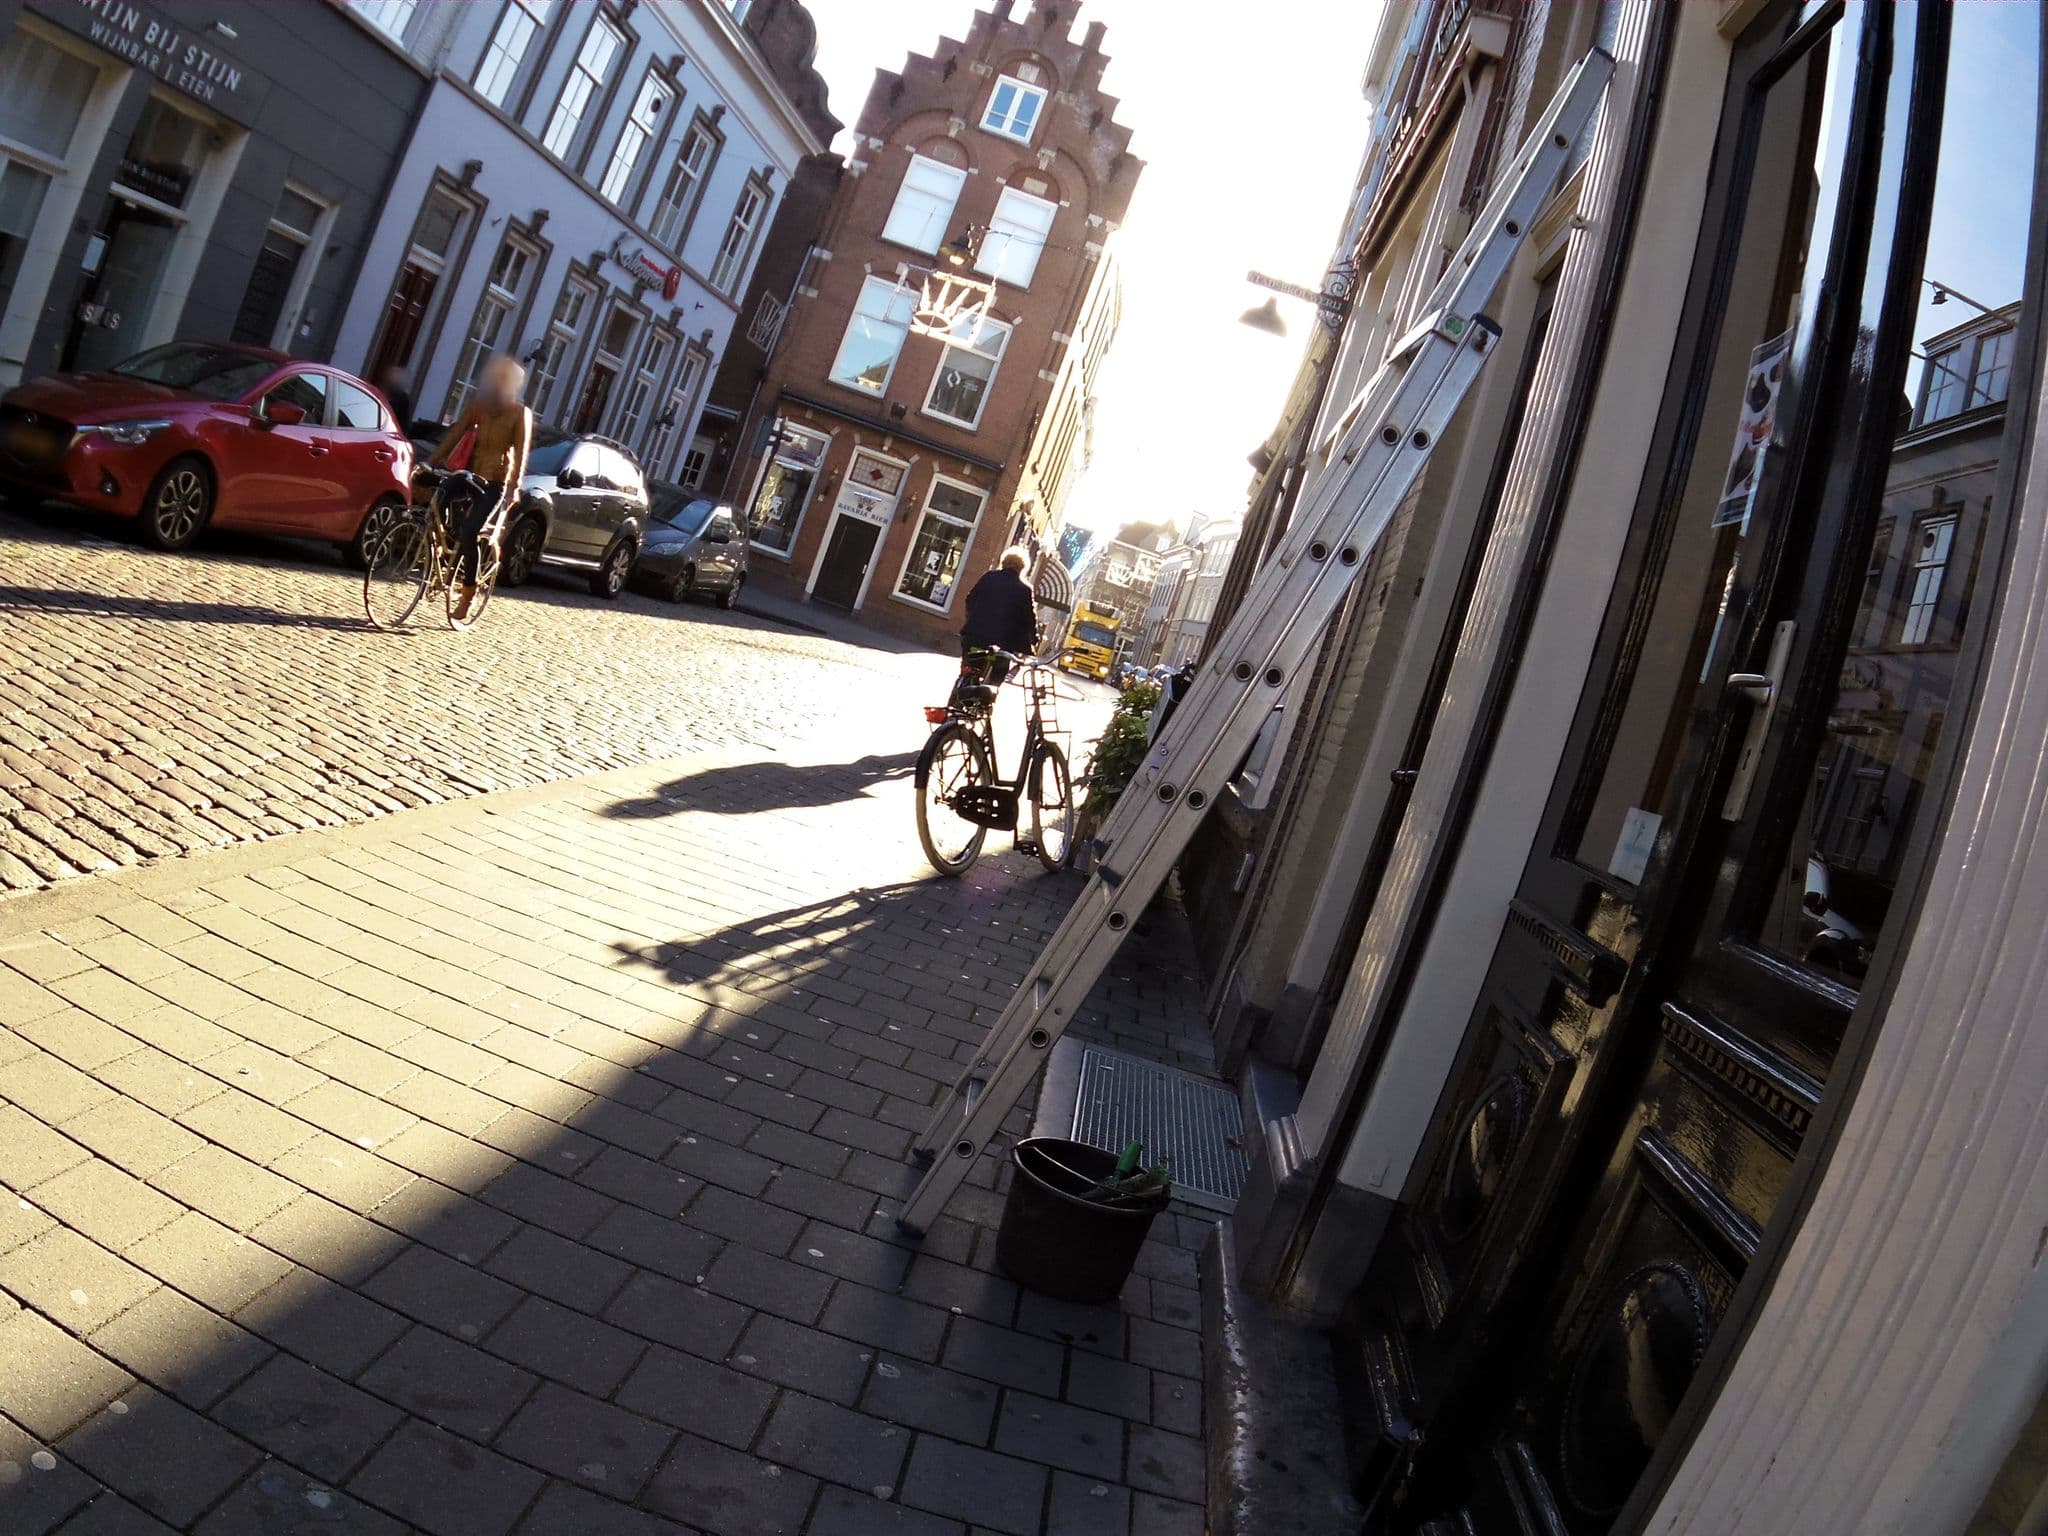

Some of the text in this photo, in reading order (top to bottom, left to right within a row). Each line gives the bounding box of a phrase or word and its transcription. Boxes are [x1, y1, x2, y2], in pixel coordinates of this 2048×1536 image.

[90, 20, 215, 101] WIJNBAR ETEN
[144, 20, 180, 54] BIJ
[183, 45, 242, 92] STIJN
